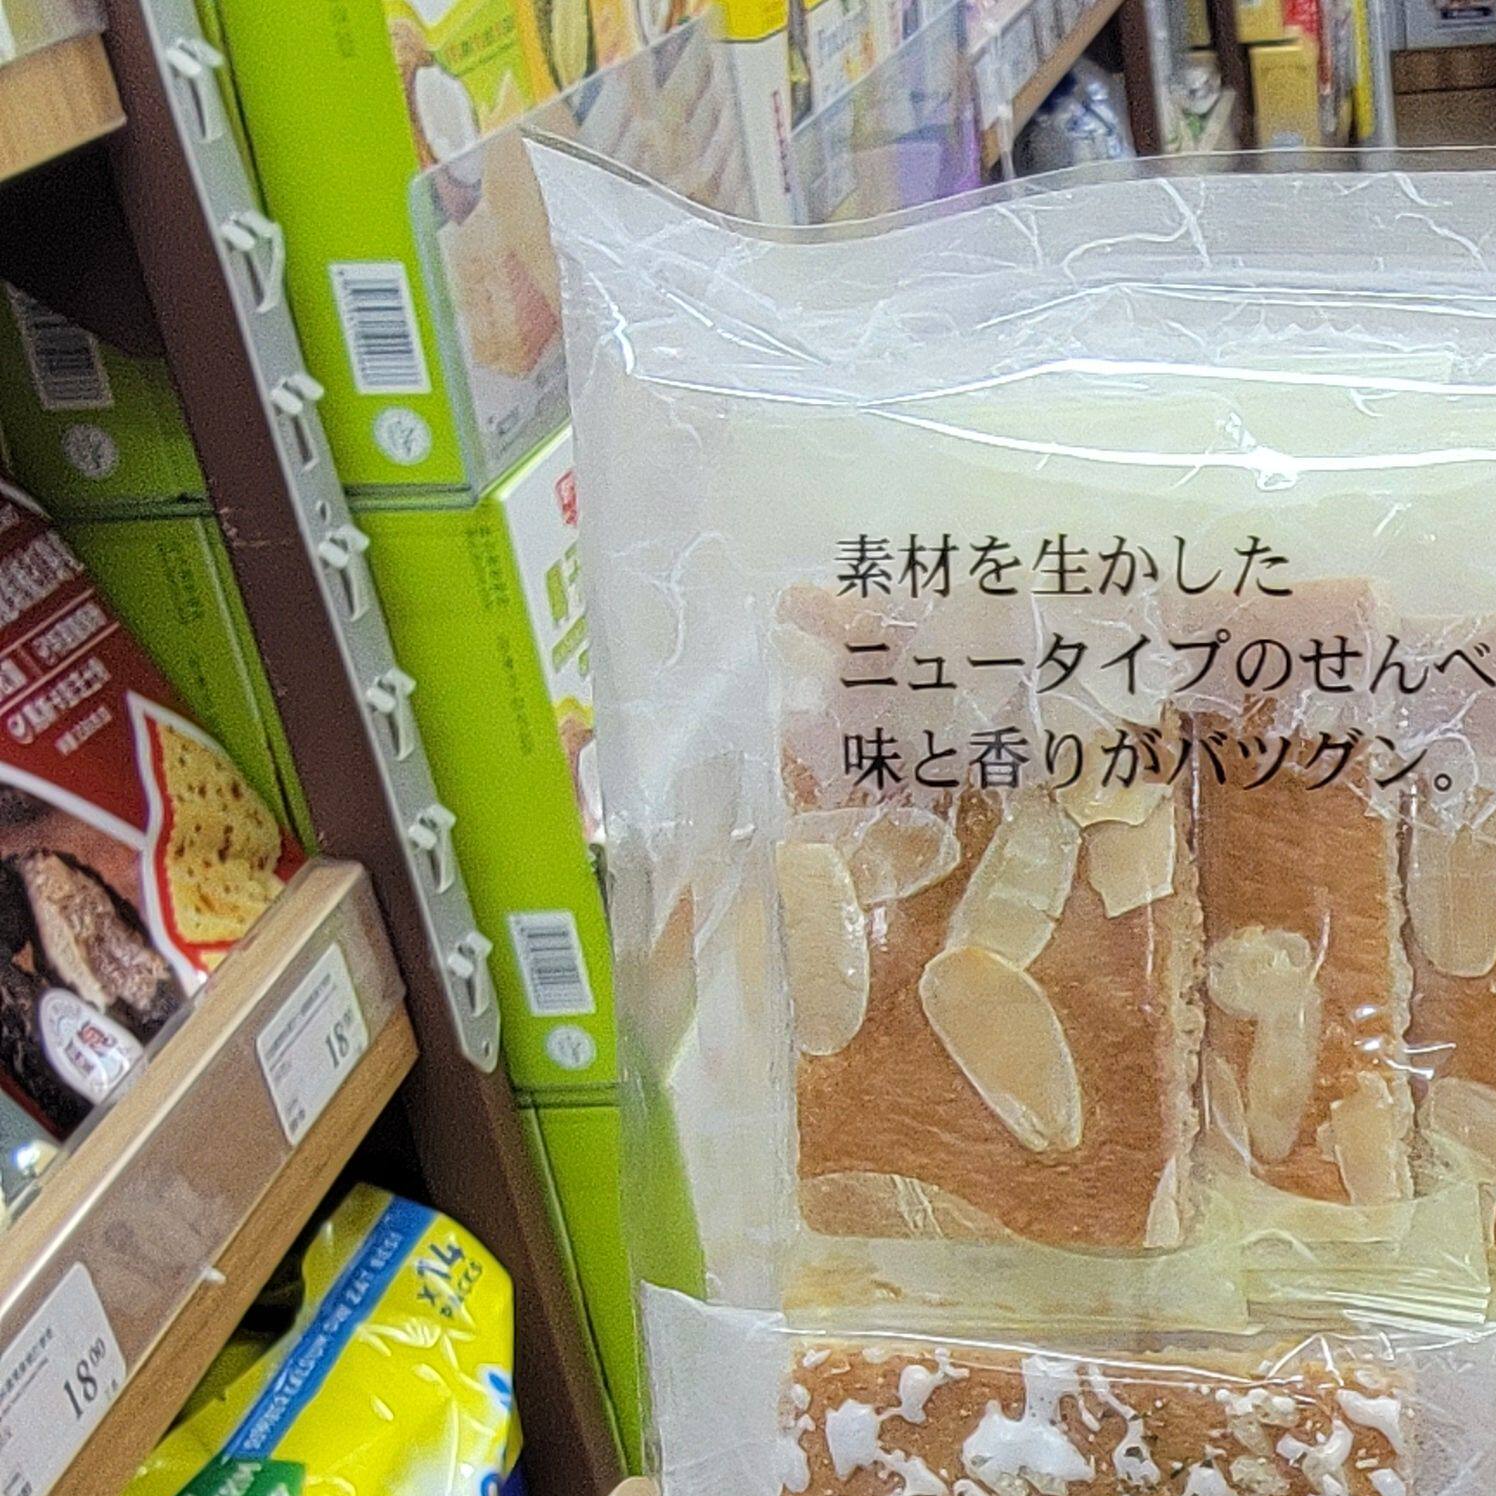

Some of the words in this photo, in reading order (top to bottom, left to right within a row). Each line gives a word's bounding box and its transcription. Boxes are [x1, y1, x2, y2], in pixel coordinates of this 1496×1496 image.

[834, 532, 1293, 599] 素材を生かした
[843, 724, 1453, 792] 味と香りがバツグン。
